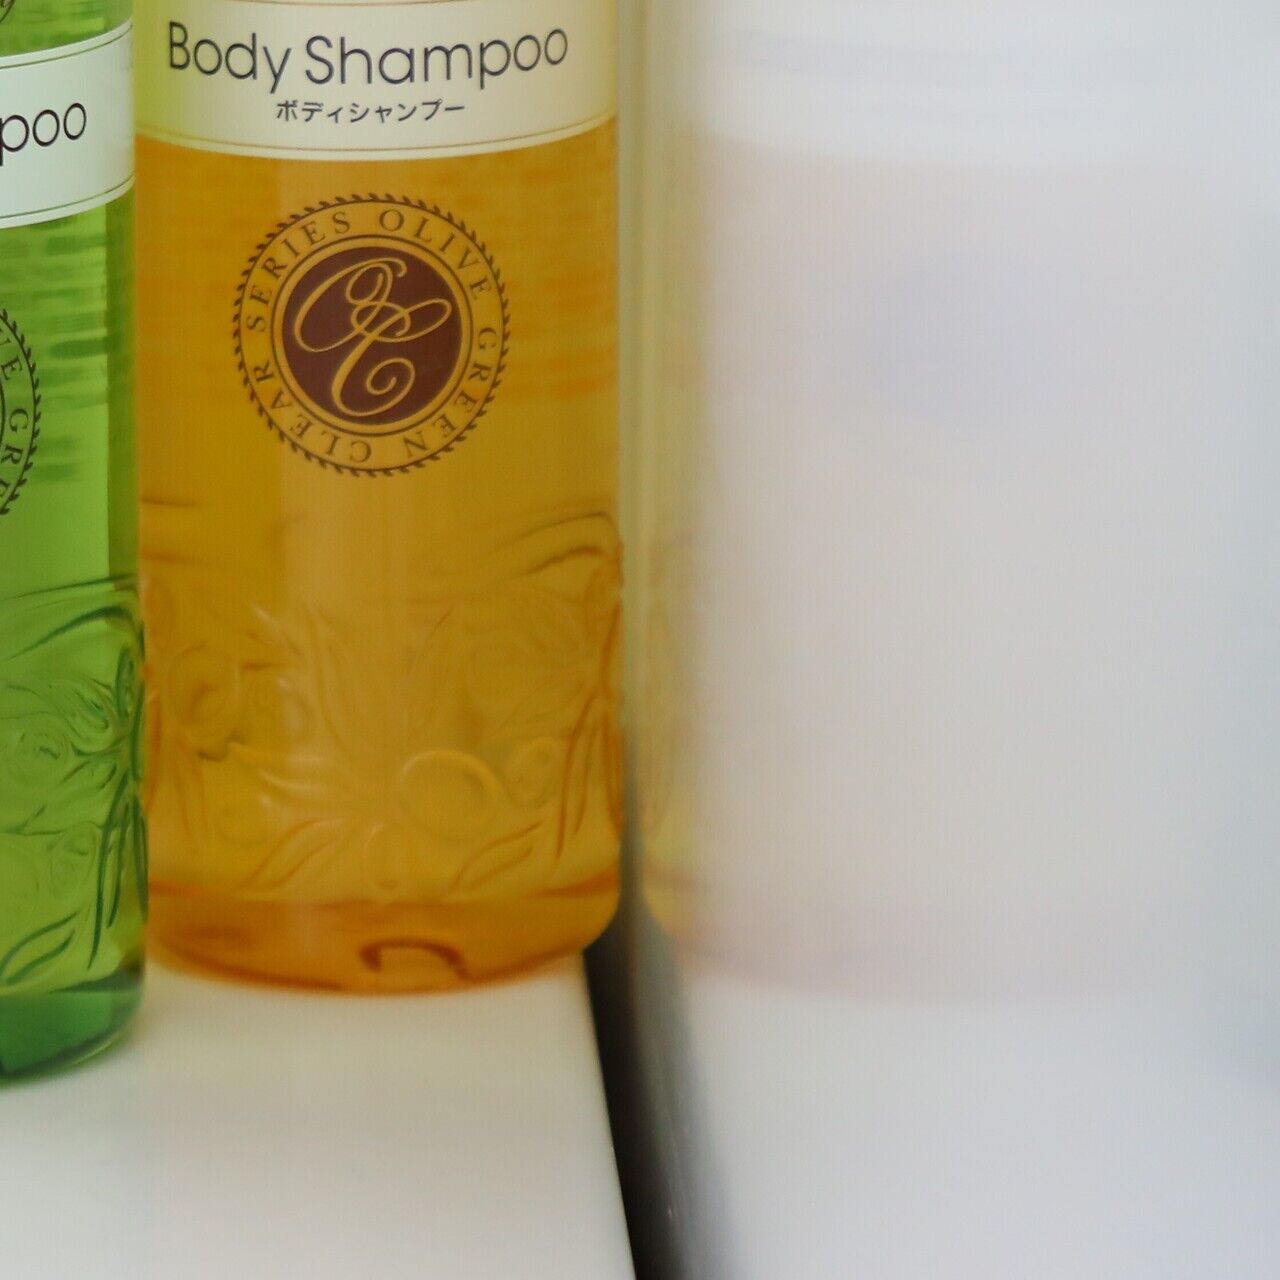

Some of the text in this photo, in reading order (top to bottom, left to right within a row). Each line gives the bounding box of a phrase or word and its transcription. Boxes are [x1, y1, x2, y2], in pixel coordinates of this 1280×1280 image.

[168, 20, 569, 94] Body Shampoo
[276, 98, 467, 124] ボディシャンプー
[246, 208, 498, 463] OLIVE GREEN CLEAR SERIES
